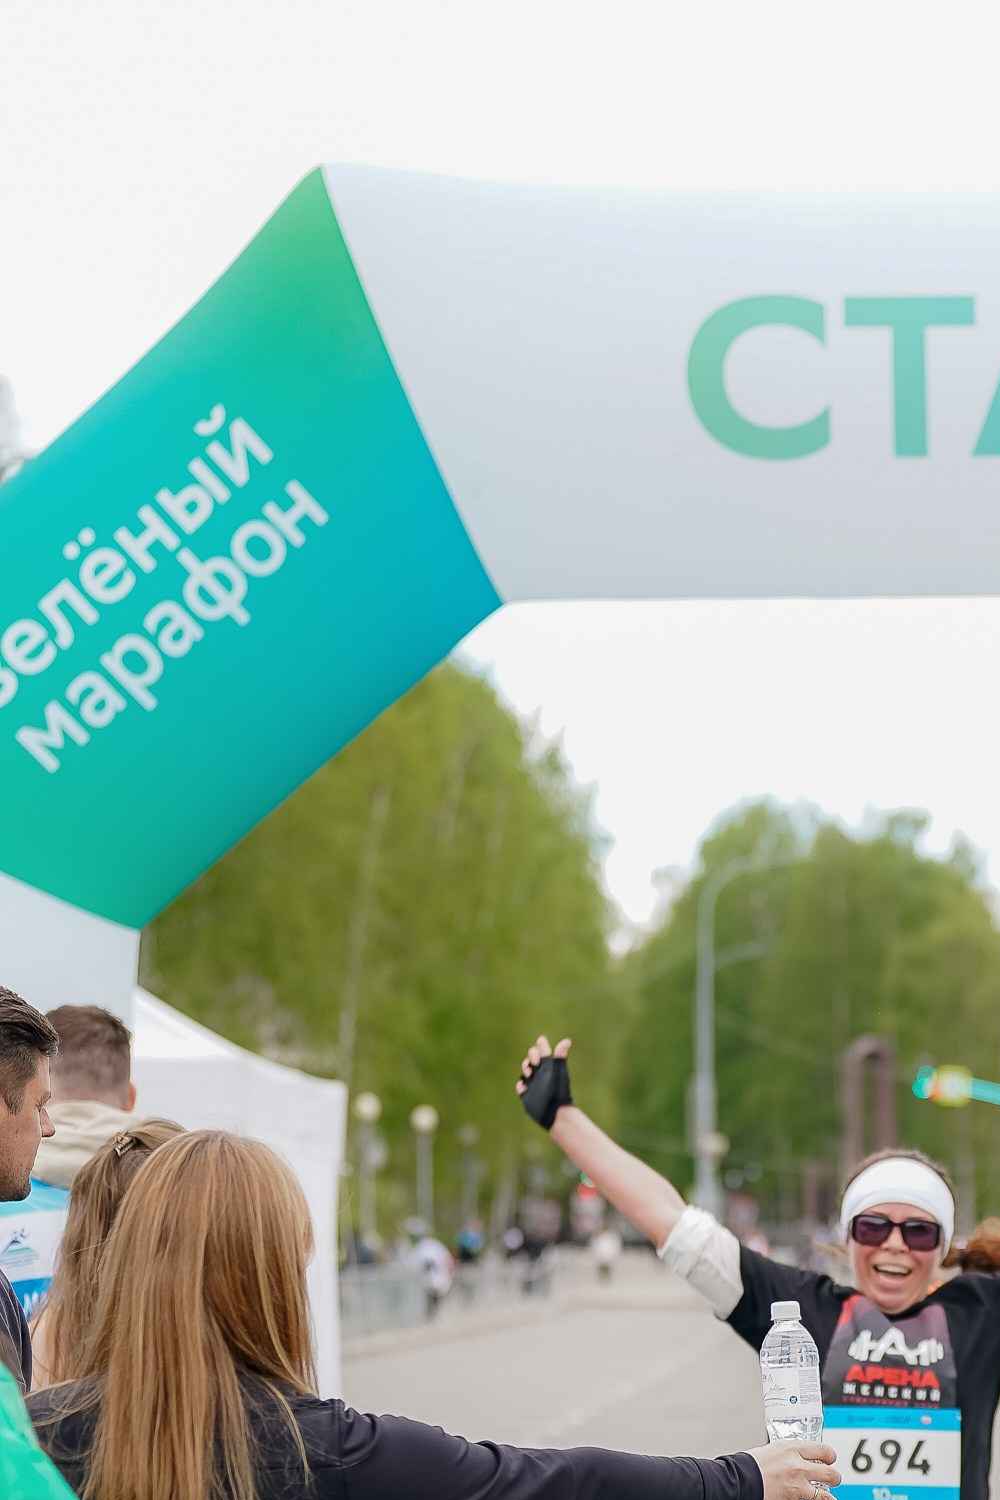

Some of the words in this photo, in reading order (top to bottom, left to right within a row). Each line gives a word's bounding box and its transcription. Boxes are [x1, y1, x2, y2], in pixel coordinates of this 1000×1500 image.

[14, 478, 330, 773] марафон
[844, 1365, 940, 1388] АРЕНА
[851, 1438, 931, 1476] 694
